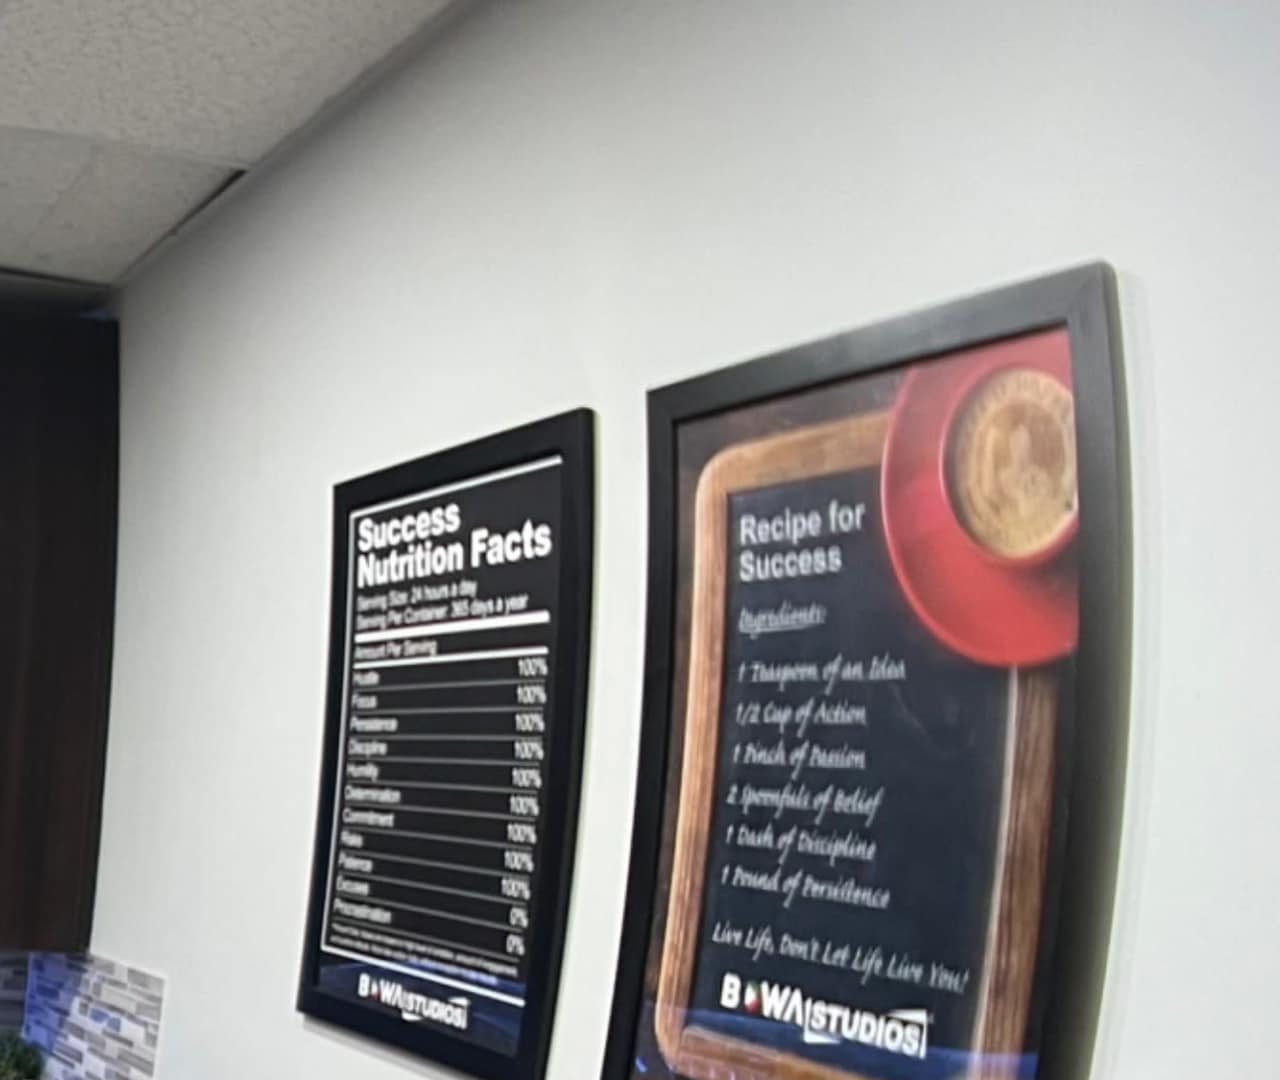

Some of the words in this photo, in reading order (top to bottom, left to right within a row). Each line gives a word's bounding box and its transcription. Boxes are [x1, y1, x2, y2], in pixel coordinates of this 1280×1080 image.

[358, 503, 461, 552] Success
[740, 507, 821, 546] Recipe
[829, 500, 866, 534] for
[357, 540, 464, 589] Nutrition
[471, 518, 552, 567] Facts
[740, 545, 842, 582] Success
[424, 583, 448, 601] hours
[459, 580, 478, 598] day
[387, 610, 402, 625] Per
[451, 600, 470, 618] 365
[470, 597, 494, 618] days
[505, 594, 529, 615] year
[738, 601, 827, 640] Ingredients:
[518, 657, 548, 676] 100%
[739, 661, 746, 683] 1
[751, 661, 818, 692] Teaspoon
[822, 652, 842, 696] of
[842, 661, 863, 680] an
[869, 653, 906, 680] Idea
[517, 685, 547, 704] 100%
[515, 712, 545, 732] 100%
[736, 702, 760, 726] 1/2
[763, 700, 791, 735] Cup
[795, 696, 815, 739] of
[814, 698, 867, 726] Action
[514, 741, 544, 760] 100%
[734, 743, 741, 764] 1
[743, 738, 786, 766] Pinch
[789, 739, 810, 780] of
[809, 742, 867, 769] Passion
[512, 767, 542, 789] 100%
[510, 796, 539, 816] 100%
[726, 783, 738, 805] 2
[741, 782, 811, 819] Spoonfuls
[813, 785, 834, 826] of
[833, 786, 886, 828] Belief
[507, 823, 537, 844] 100%
[726, 824, 734, 844] 1
[736, 822, 774, 848] Dash
[777, 824, 798, 865] of
[797, 830, 877, 867] Discipline
[504, 850, 534, 872] 100%
[501, 877, 531, 900] 100%
[721, 864, 730, 885] 1
[732, 864, 782, 892] Pound
[782, 869, 803, 909] of
[801, 874, 890, 909] Persistence
[510, 907, 528, 928] 0%
[506, 934, 525, 956] 0%
[712, 920, 741, 944] Live
[744, 924, 774, 962] Life,
[779, 934, 820, 962] Don't
[821, 940, 852, 969] Let
[851, 946, 883, 985] Life
[886, 952, 926, 982] Live
[928, 961, 970, 995] You!
[406, 993, 464, 1028] STUDIOS
[810, 1000, 922, 1057] STUDIOS
